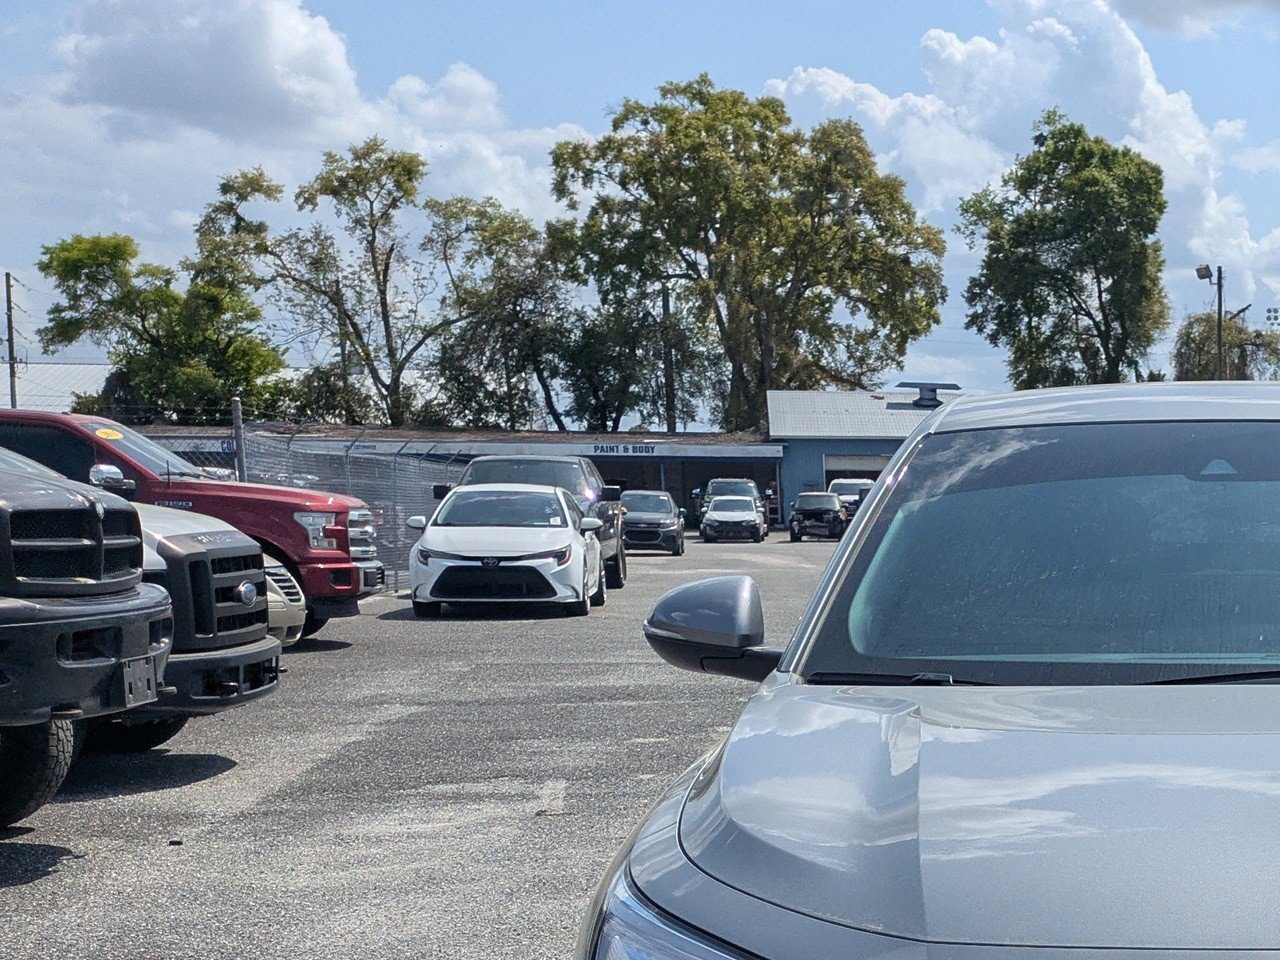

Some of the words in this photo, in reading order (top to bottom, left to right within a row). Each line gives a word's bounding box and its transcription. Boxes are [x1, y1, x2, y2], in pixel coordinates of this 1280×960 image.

[593, 445, 620, 454] PAINT
[623, 445, 630, 454] &
[632, 445, 656, 454] BODY
